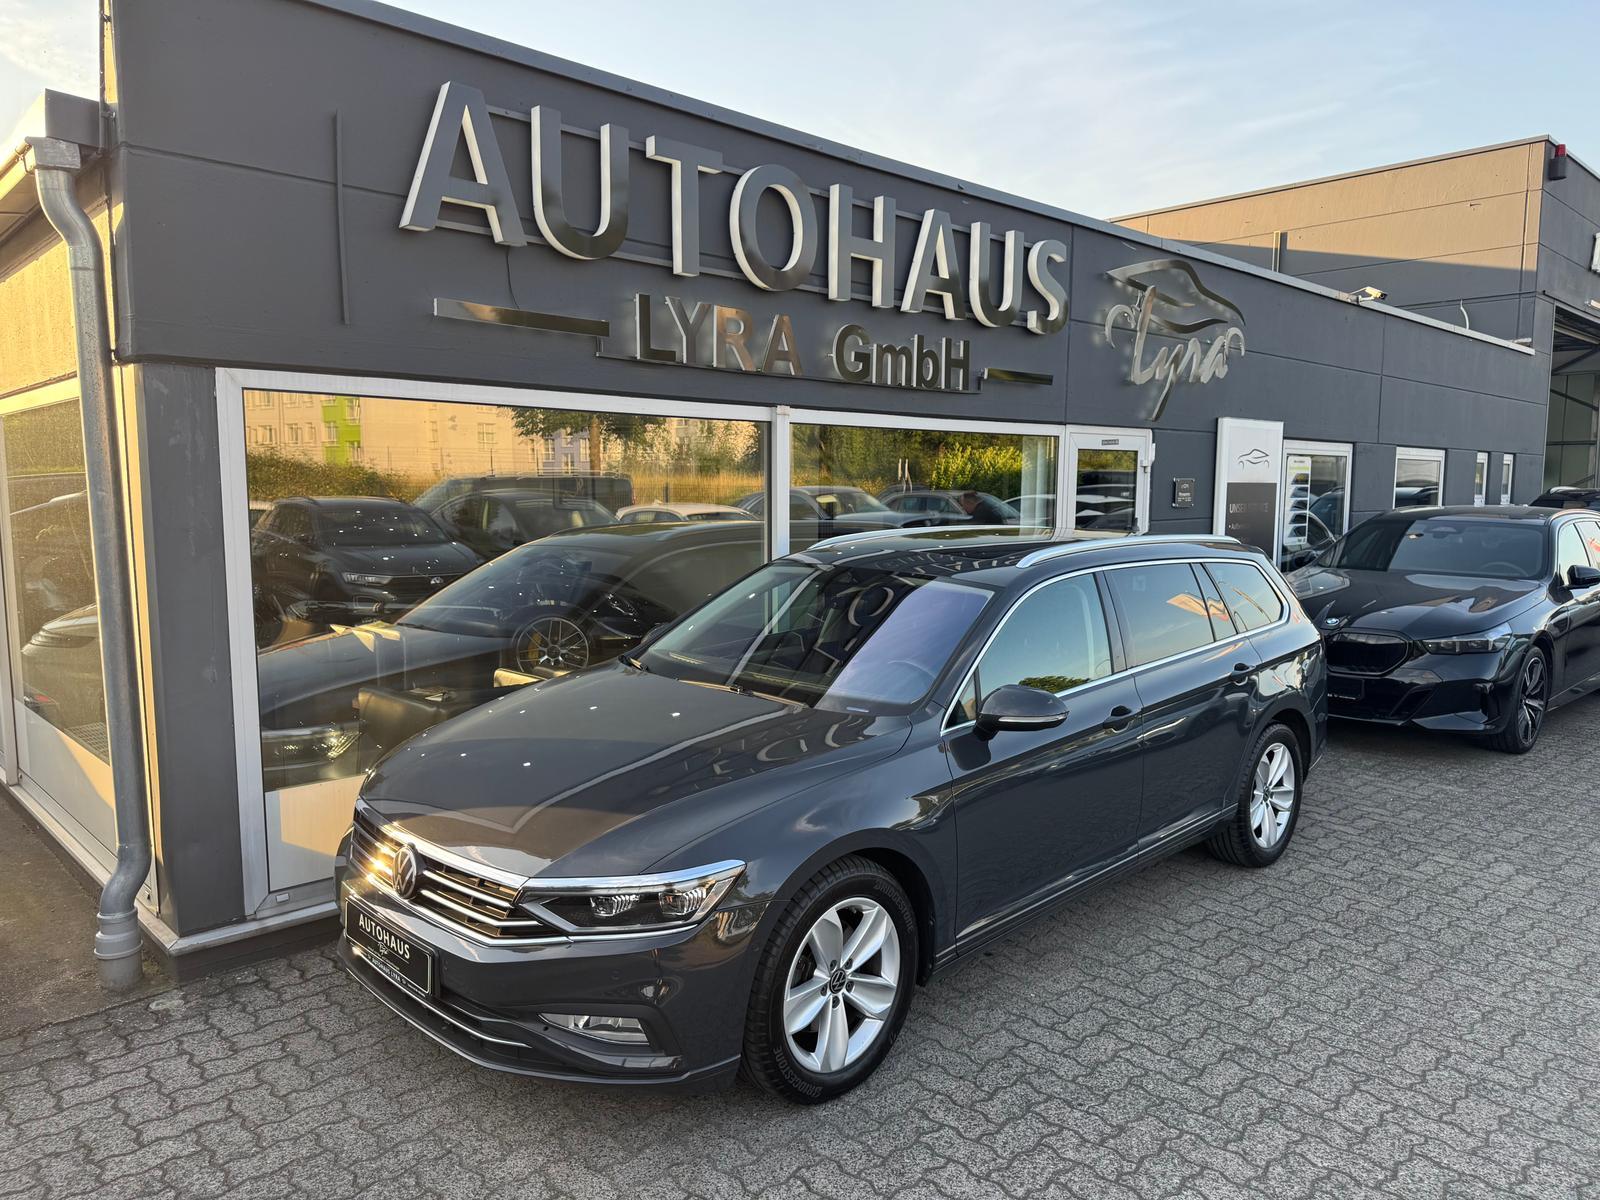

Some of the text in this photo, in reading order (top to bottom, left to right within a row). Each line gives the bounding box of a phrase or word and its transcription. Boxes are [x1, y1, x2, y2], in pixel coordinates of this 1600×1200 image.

[398, 80, 1069, 335] AUTOHAUS
[635, 292, 971, 392] LYRA GmbH
[358, 913, 411, 960] AUTOHAUS
